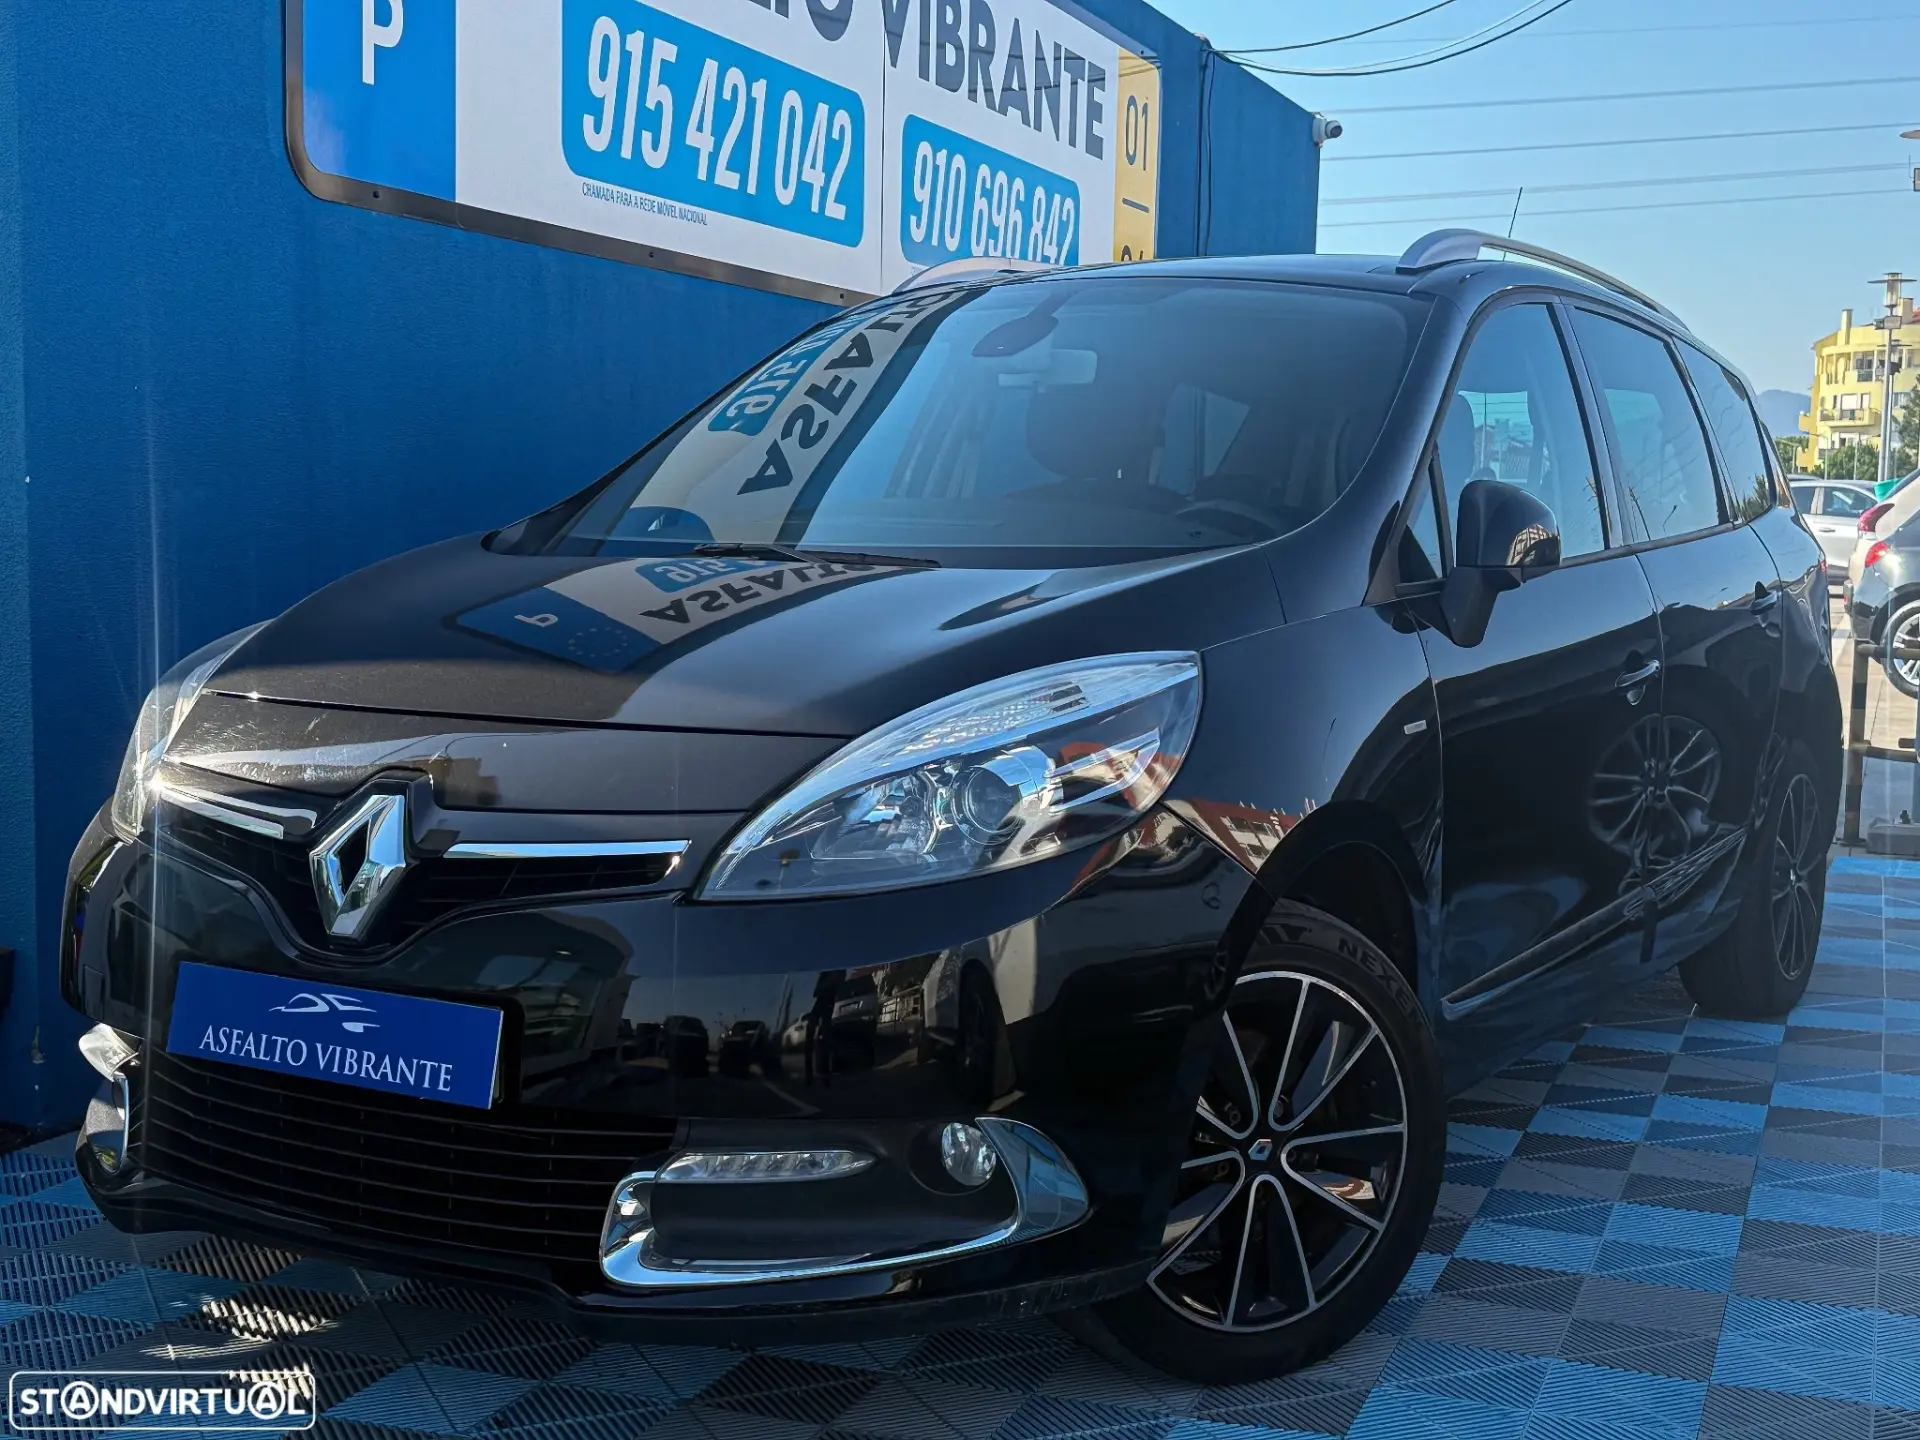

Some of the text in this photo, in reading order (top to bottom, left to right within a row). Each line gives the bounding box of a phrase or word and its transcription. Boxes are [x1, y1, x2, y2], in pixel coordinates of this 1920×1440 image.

[362, 0, 404, 85] P
[883, 0, 1106, 161] VIBRANTE
[582, 15, 851, 221] 915 421 042
[1125, 94, 1149, 172] 01
[581, 181, 615, 204] CHAMADA
[616, 190, 632, 208] PARA
[639, 197, 656, 214] REDE
[656, 200, 678, 220] MÓVEL
[678, 207, 708, 226] NACIONAL
[909, 140, 1075, 266] 910 696 842
[199, 1024, 453, 1092] ASFALTO VIBRANTE
